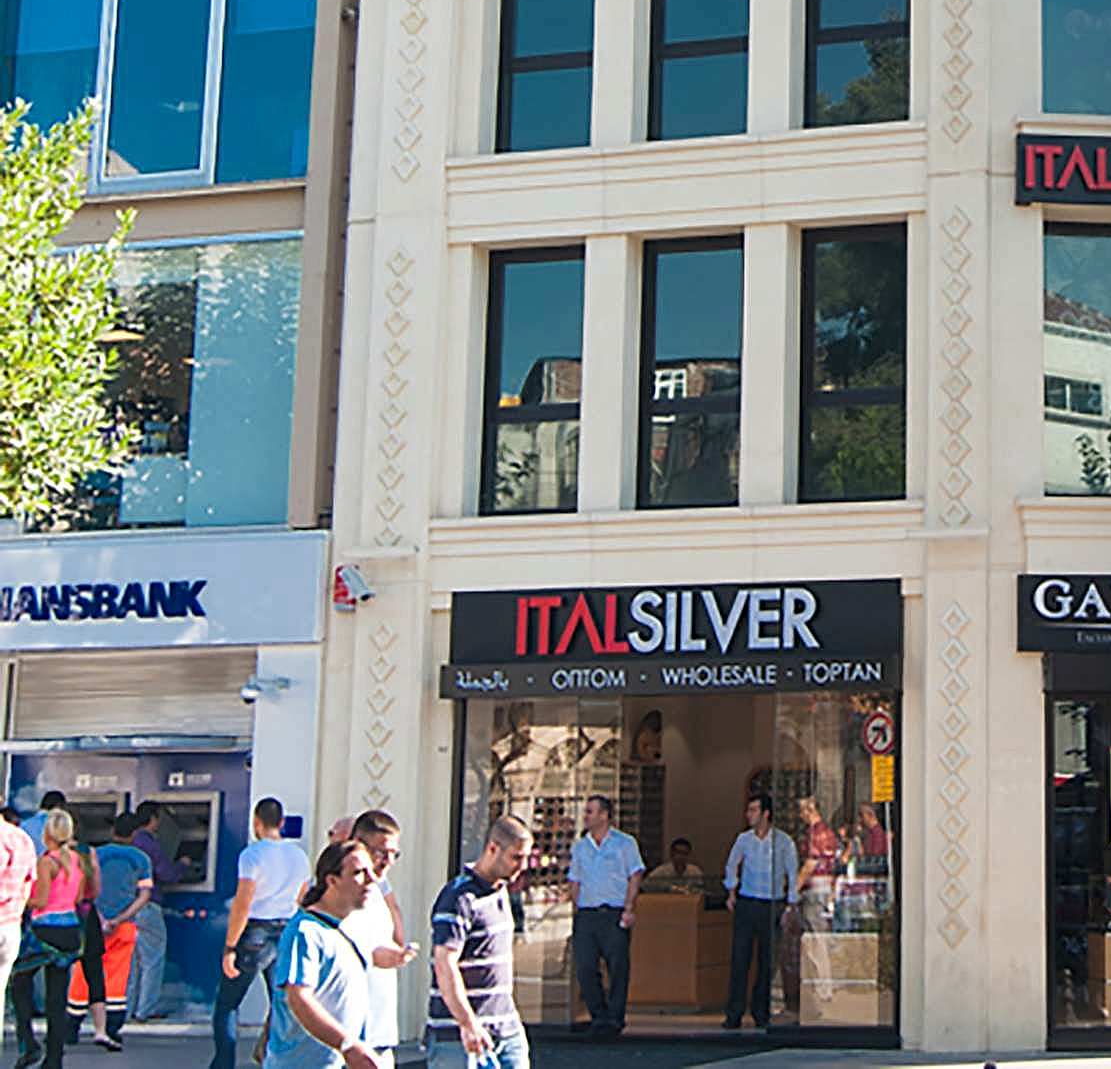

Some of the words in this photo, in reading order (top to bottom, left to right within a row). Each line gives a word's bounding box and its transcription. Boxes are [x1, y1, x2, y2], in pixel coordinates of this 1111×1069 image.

[515, 588, 820, 656] ITALSILVER
[662, 665, 776, 686] WHOLESALE
[804, 663, 882, 683] TOPTAN
